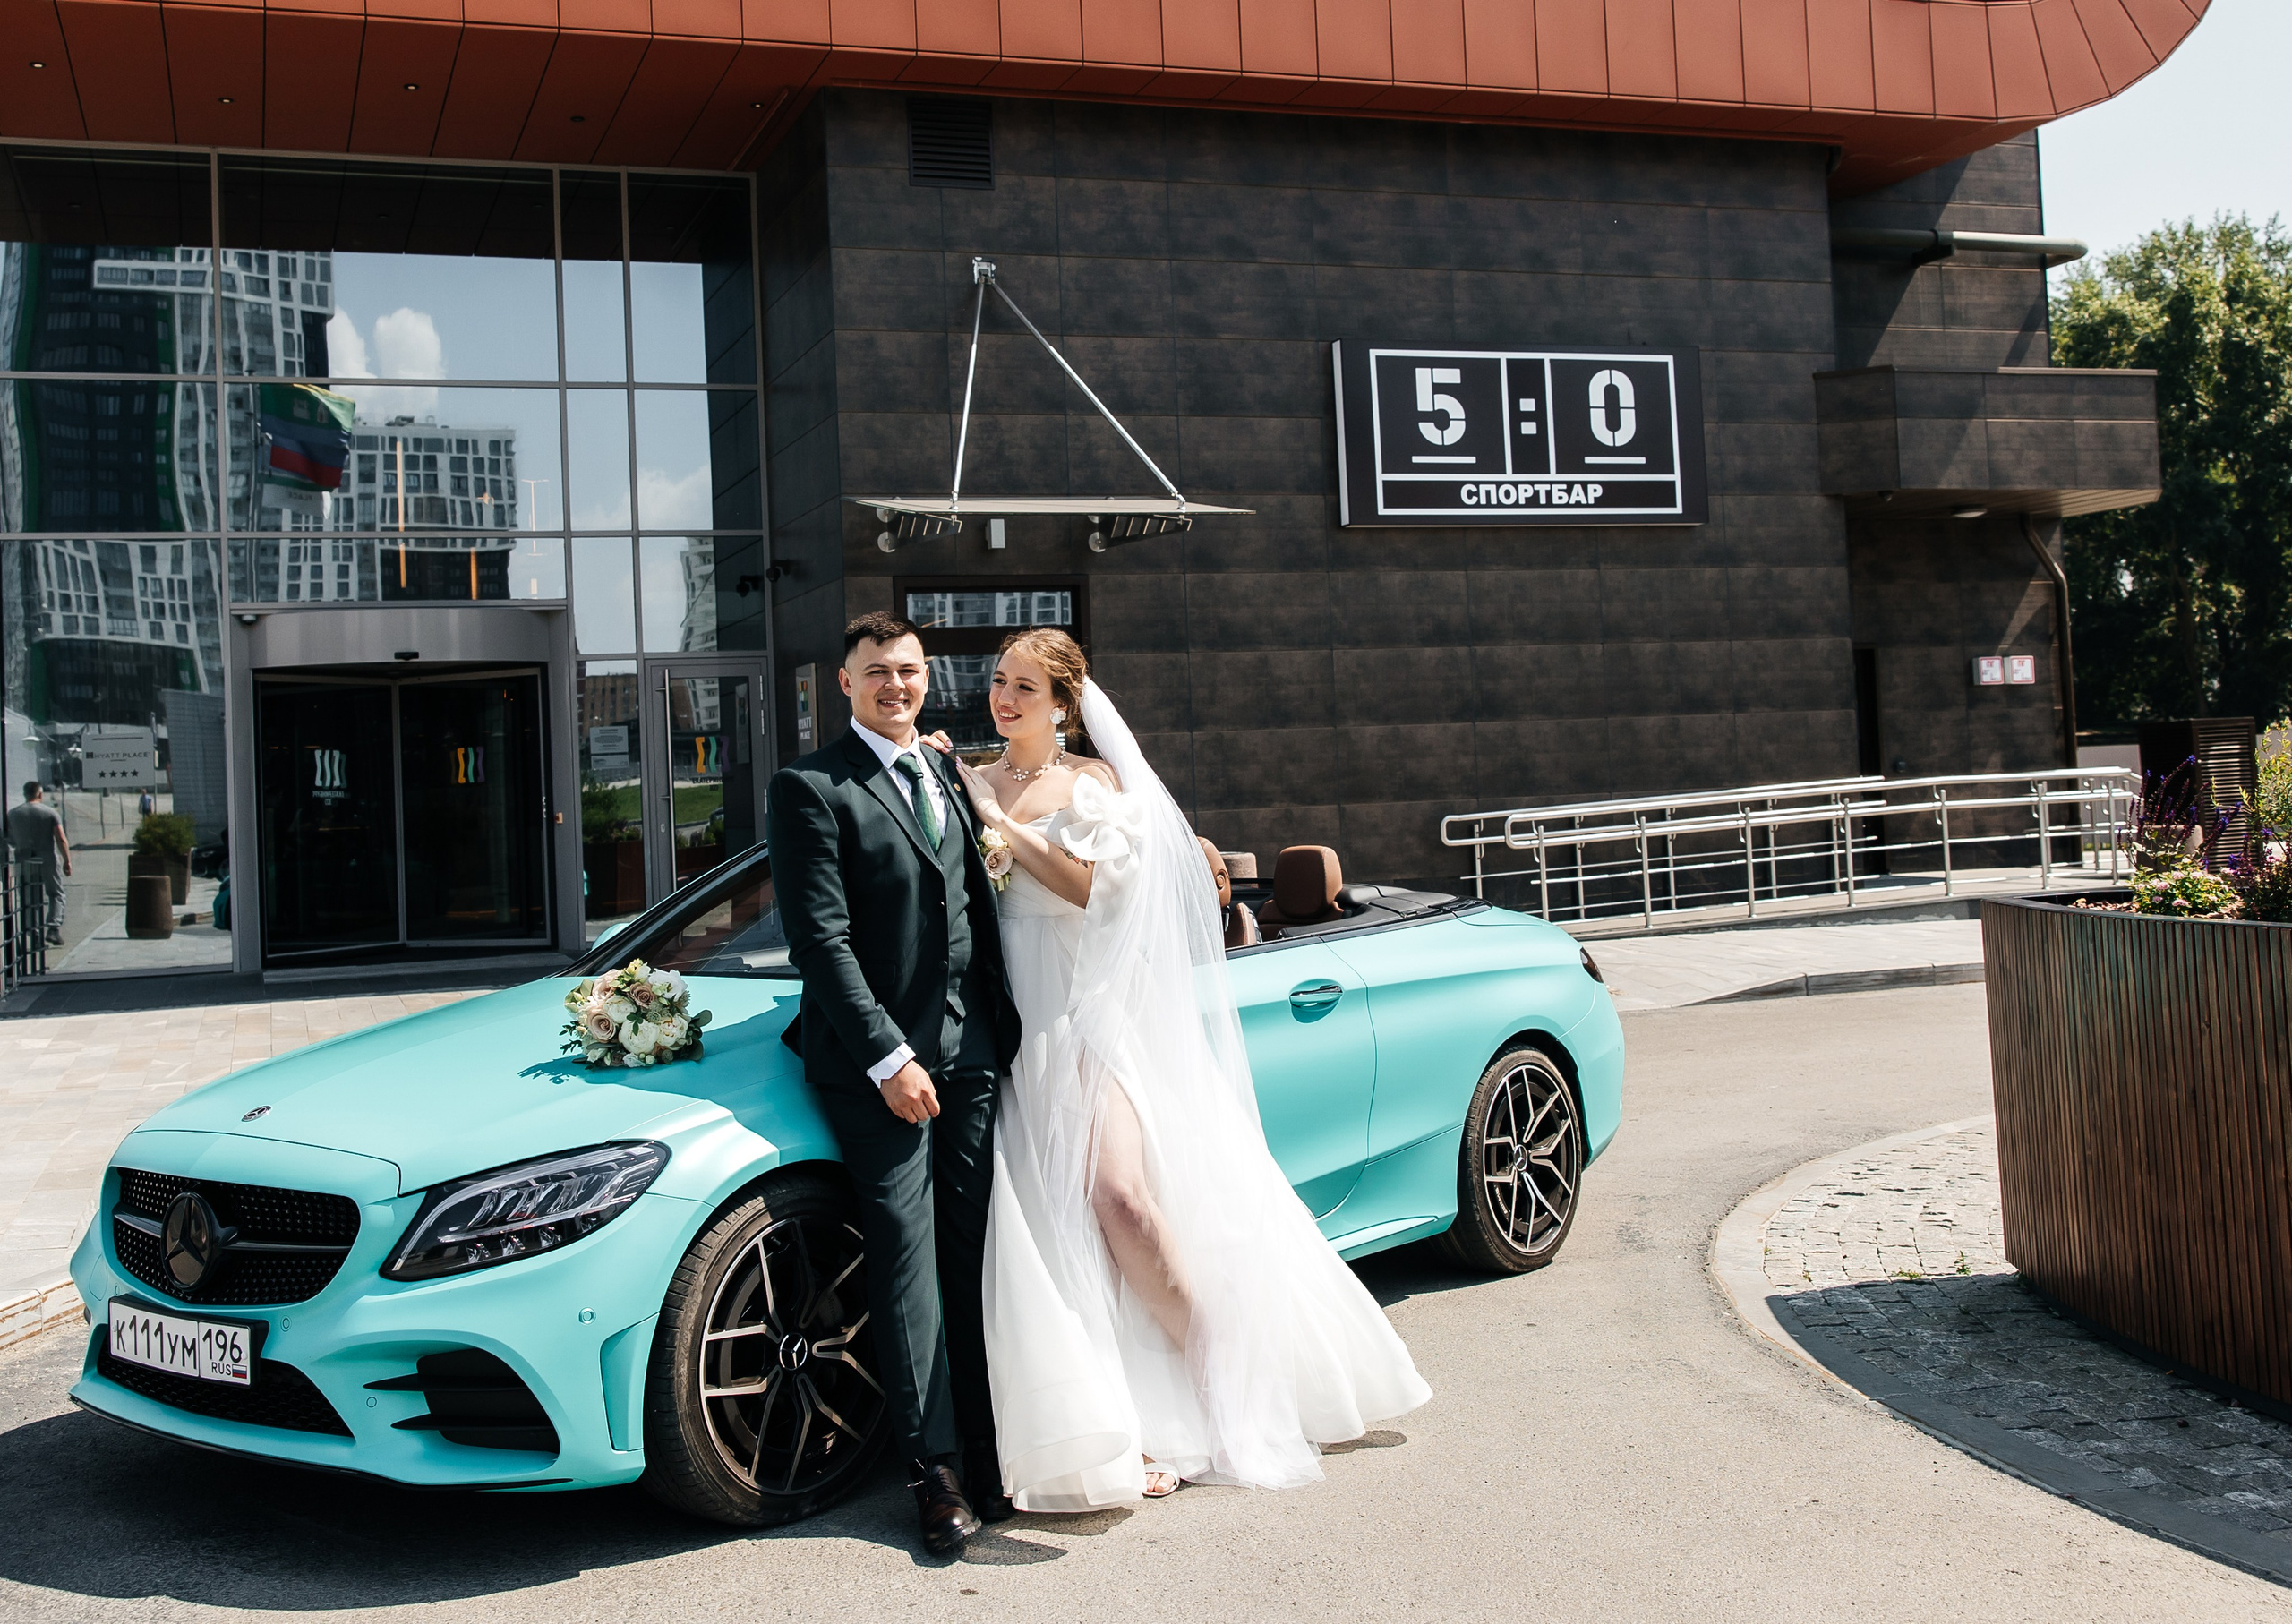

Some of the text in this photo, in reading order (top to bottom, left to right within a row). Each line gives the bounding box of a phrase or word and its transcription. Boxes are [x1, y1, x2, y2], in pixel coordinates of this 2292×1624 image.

[1415, 367, 1466, 446] 5
[1588, 369, 1637, 447] 0
[1460, 483, 1604, 505] СПОРТБАР
[116, 1314, 243, 1370] К111УМ 196
[211, 1362, 232, 1376] RUS
